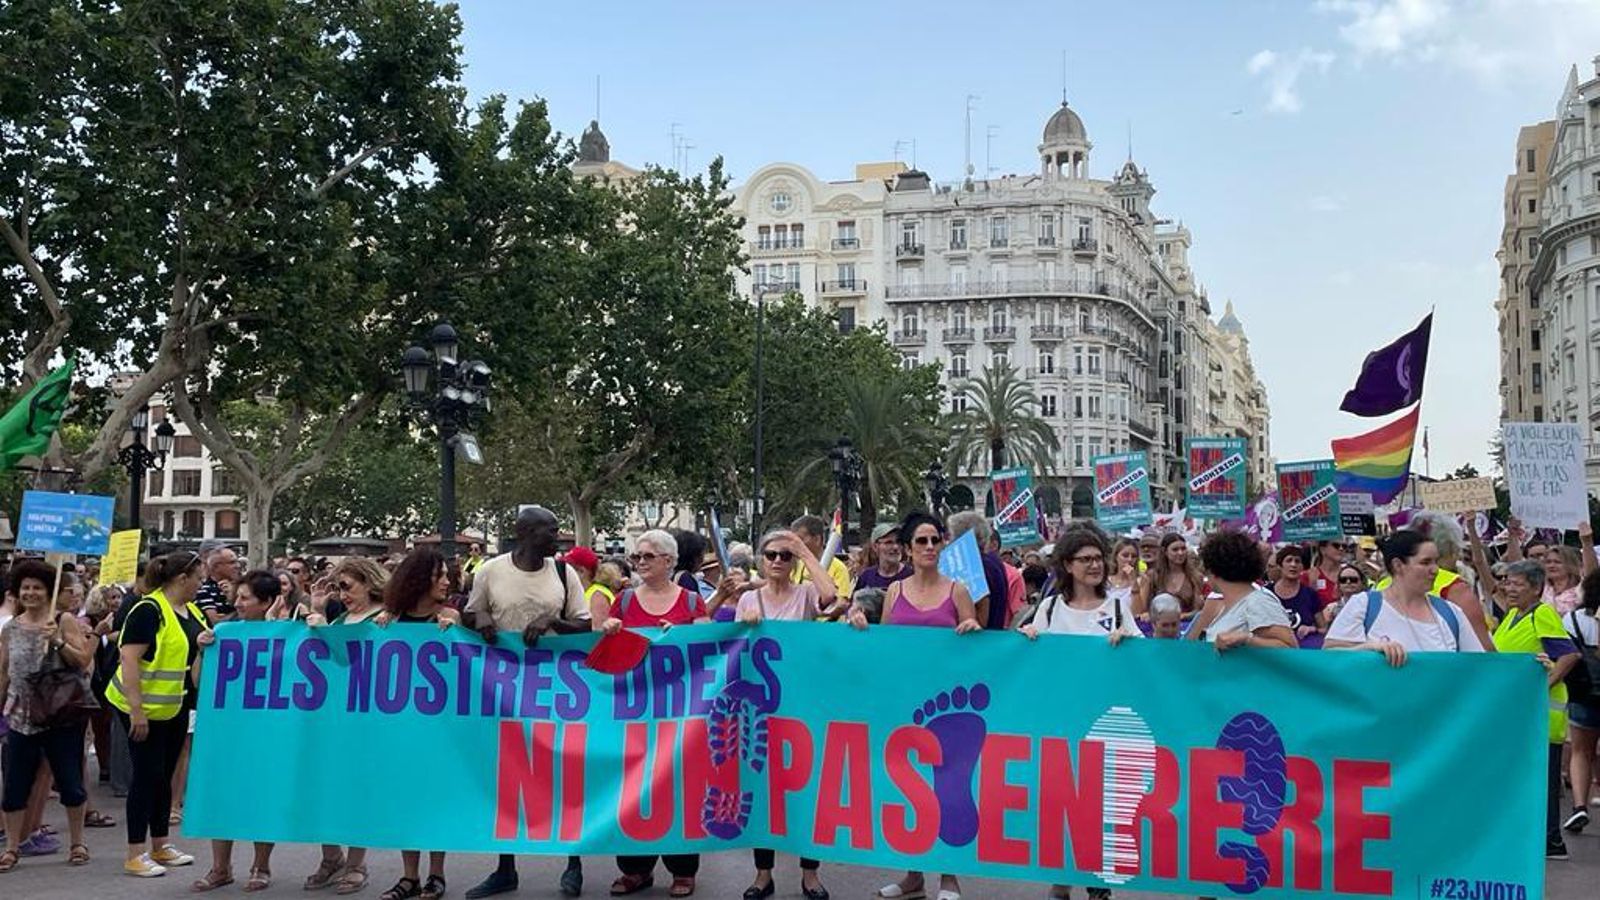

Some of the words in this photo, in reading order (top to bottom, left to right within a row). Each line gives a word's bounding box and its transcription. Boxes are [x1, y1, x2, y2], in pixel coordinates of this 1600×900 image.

[1520, 426, 1581, 440] VIOLENCIA
[1507, 441, 1576, 461] MACHISTA
[1192, 456, 1241, 488] PROHIBIDA
[1509, 463, 1540, 480] MATA
[1100, 470, 1145, 500] PROHIBIDA
[1543, 480, 1563, 497] ETA
[1285, 486, 1334, 518] PROHIBIDA
[213, 638, 331, 711] PELS
[346, 639, 591, 721] NOSTRES
[613, 637, 783, 720] DRETS
[494, 720, 587, 842] NI
[618, 718, 740, 842] UN
[767, 716, 944, 856] PAS
[1430, 878, 1527, 900] #23JVOTA
